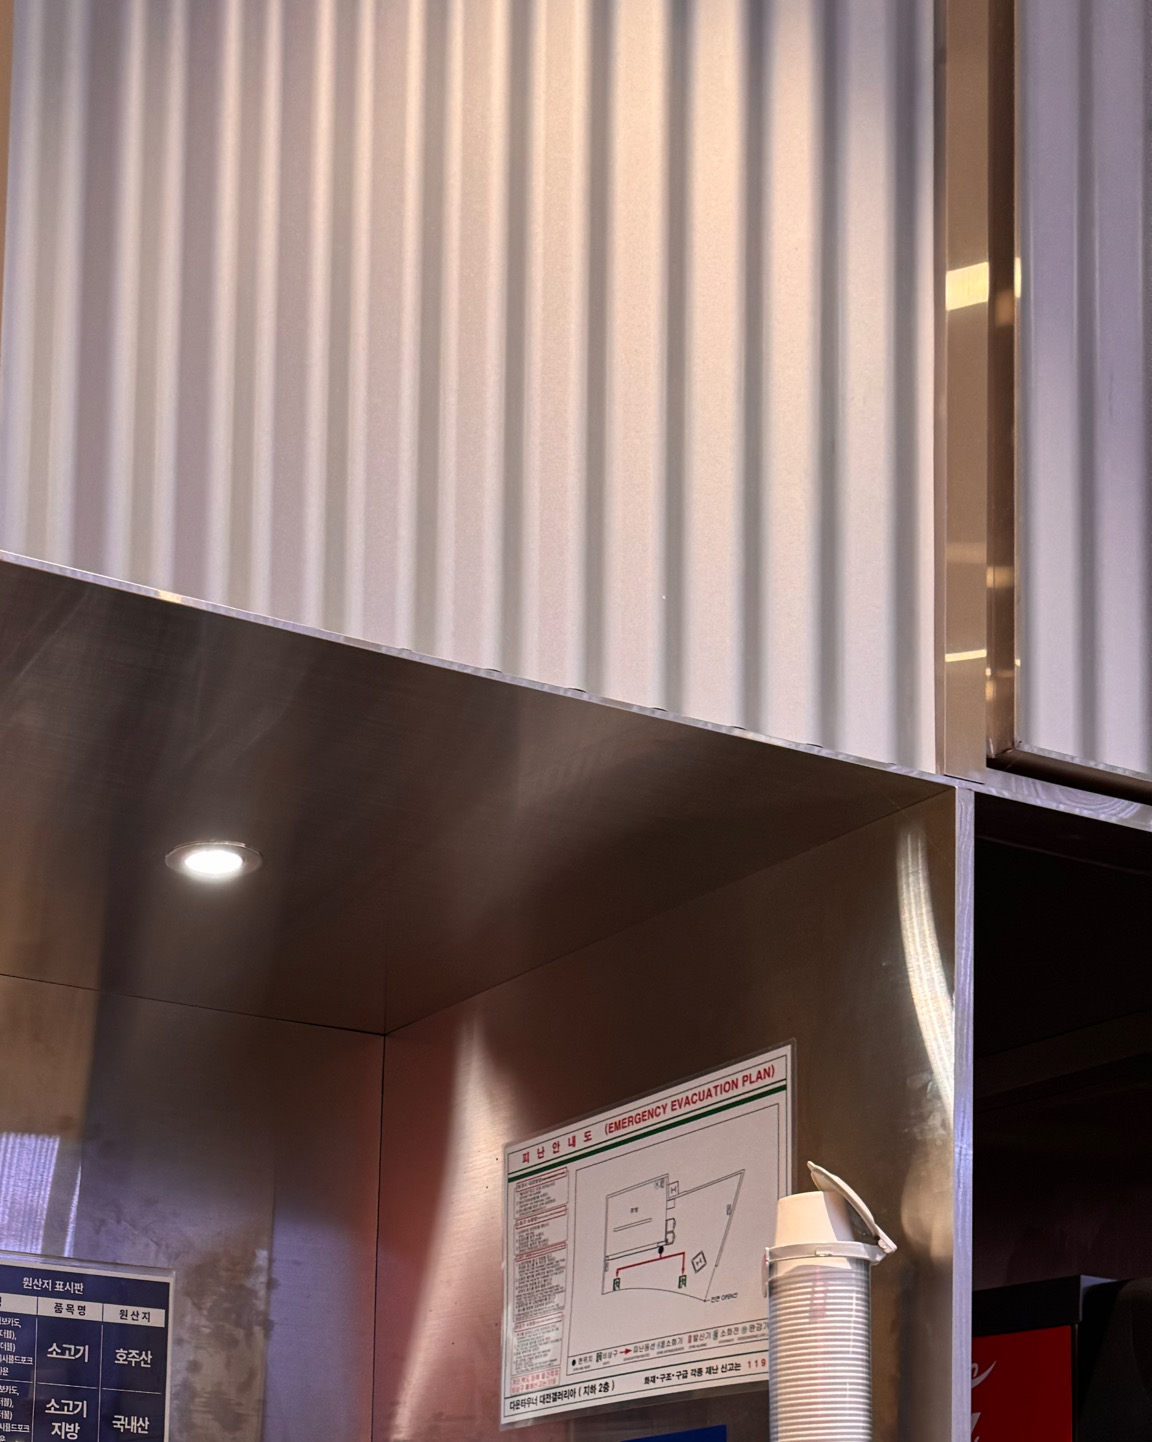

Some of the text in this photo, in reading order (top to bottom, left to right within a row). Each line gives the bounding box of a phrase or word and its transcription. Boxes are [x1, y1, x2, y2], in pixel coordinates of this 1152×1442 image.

[604, 1103, 668, 1135] (EMERGENCY
[670, 1077, 739, 1112] EVACUATION
[742, 1064, 775, 1087] PLAN)
[23, 1277, 84, 1295] 원산지 표시판
[54, 1302, 86, 1316] 품목명
[119, 1309, 151, 1323] 원산지
[47, 1343, 89, 1362] 소고기
[114, 1348, 152, 1367] 호주산
[45, 1398, 87, 1418] 소고기
[51, 1421, 80, 1440] 지방
[112, 1414, 149, 1434] 국내산
